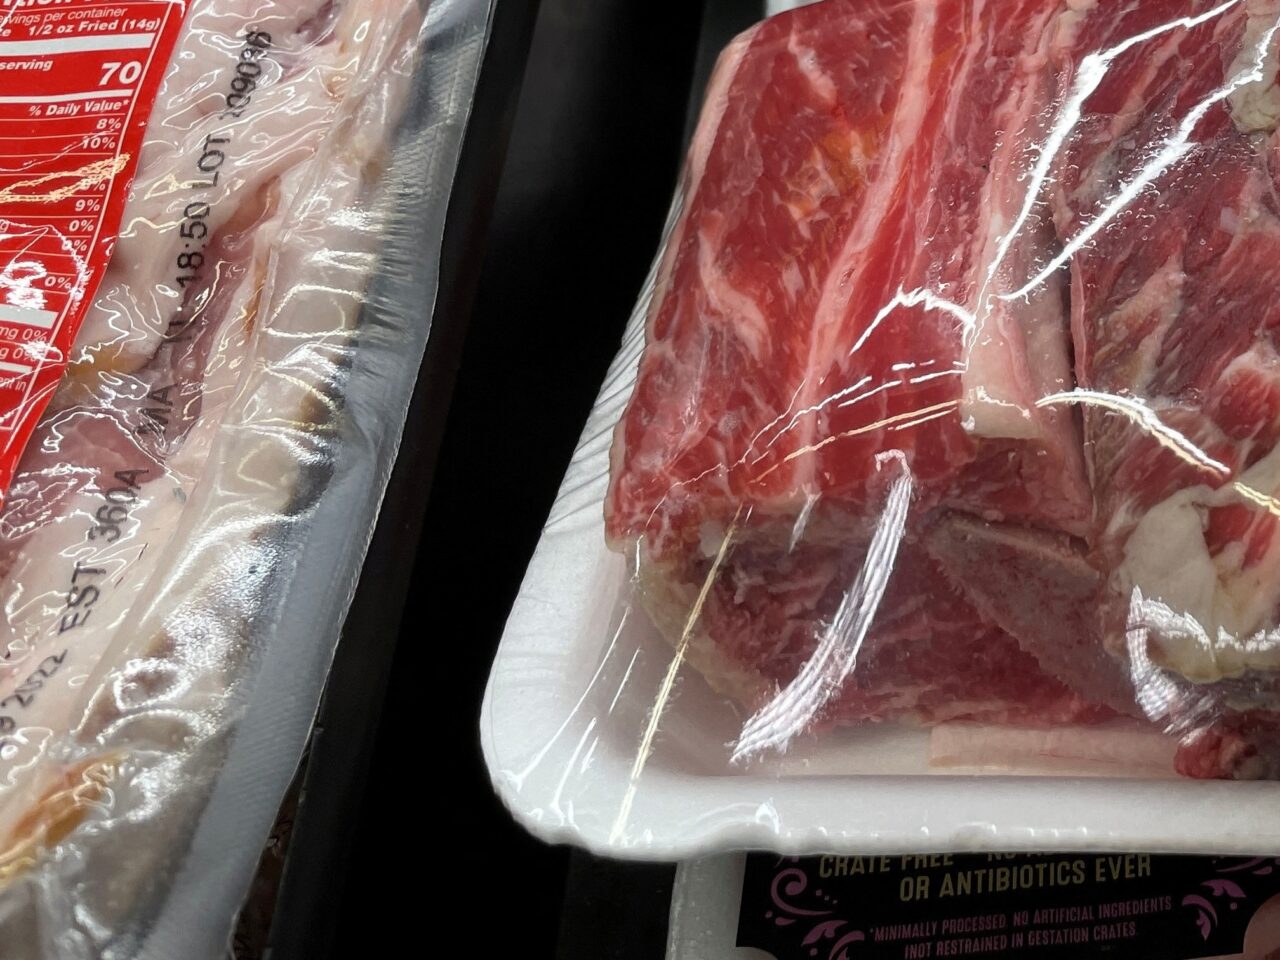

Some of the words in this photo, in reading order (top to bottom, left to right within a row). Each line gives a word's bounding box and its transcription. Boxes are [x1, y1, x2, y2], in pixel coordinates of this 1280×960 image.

[43, 11, 65, 24] per
[67, 7, 129, 22] container
[28, 25, 53, 36] 1/2
[56, 25, 74, 34] oz
[78, 20, 118, 33] Fried
[122, 18, 162, 32] (14g)
[0, 59, 53, 72] serving
[99, 61, 142, 87] 70
[28, 105, 42, 116] %
[46, 103, 82, 117] Daily
[96, 118, 122, 130] 8%
[82, 135, 116, 150] 10%
[191, 133, 231, 190] LOT
[75, 199, 101, 212] 9%
[68, 219, 95, 233] 0%
[175, 200, 212, 290] 18:50
[44, 276, 72, 290] 0%
[22, 328, 48, 342] 0%
[57, 560, 107, 636] EST
[899, 875, 932, 903] OR
[938, 859, 1088, 899] ANTIBIOTICS
[1094, 855, 1153, 882] EVER
[1012, 914, 1031, 929] NO
[1033, 904, 1096, 927] ARTIFICIAL
[1097, 895, 1173, 920] INGREDIENTS
[937, 935, 1009, 957] RESTRAINED
[1011, 933, 1025, 950] IN
[1028, 927, 1091, 948] GESTATION
[1092, 921, 1138, 941] CRATES
